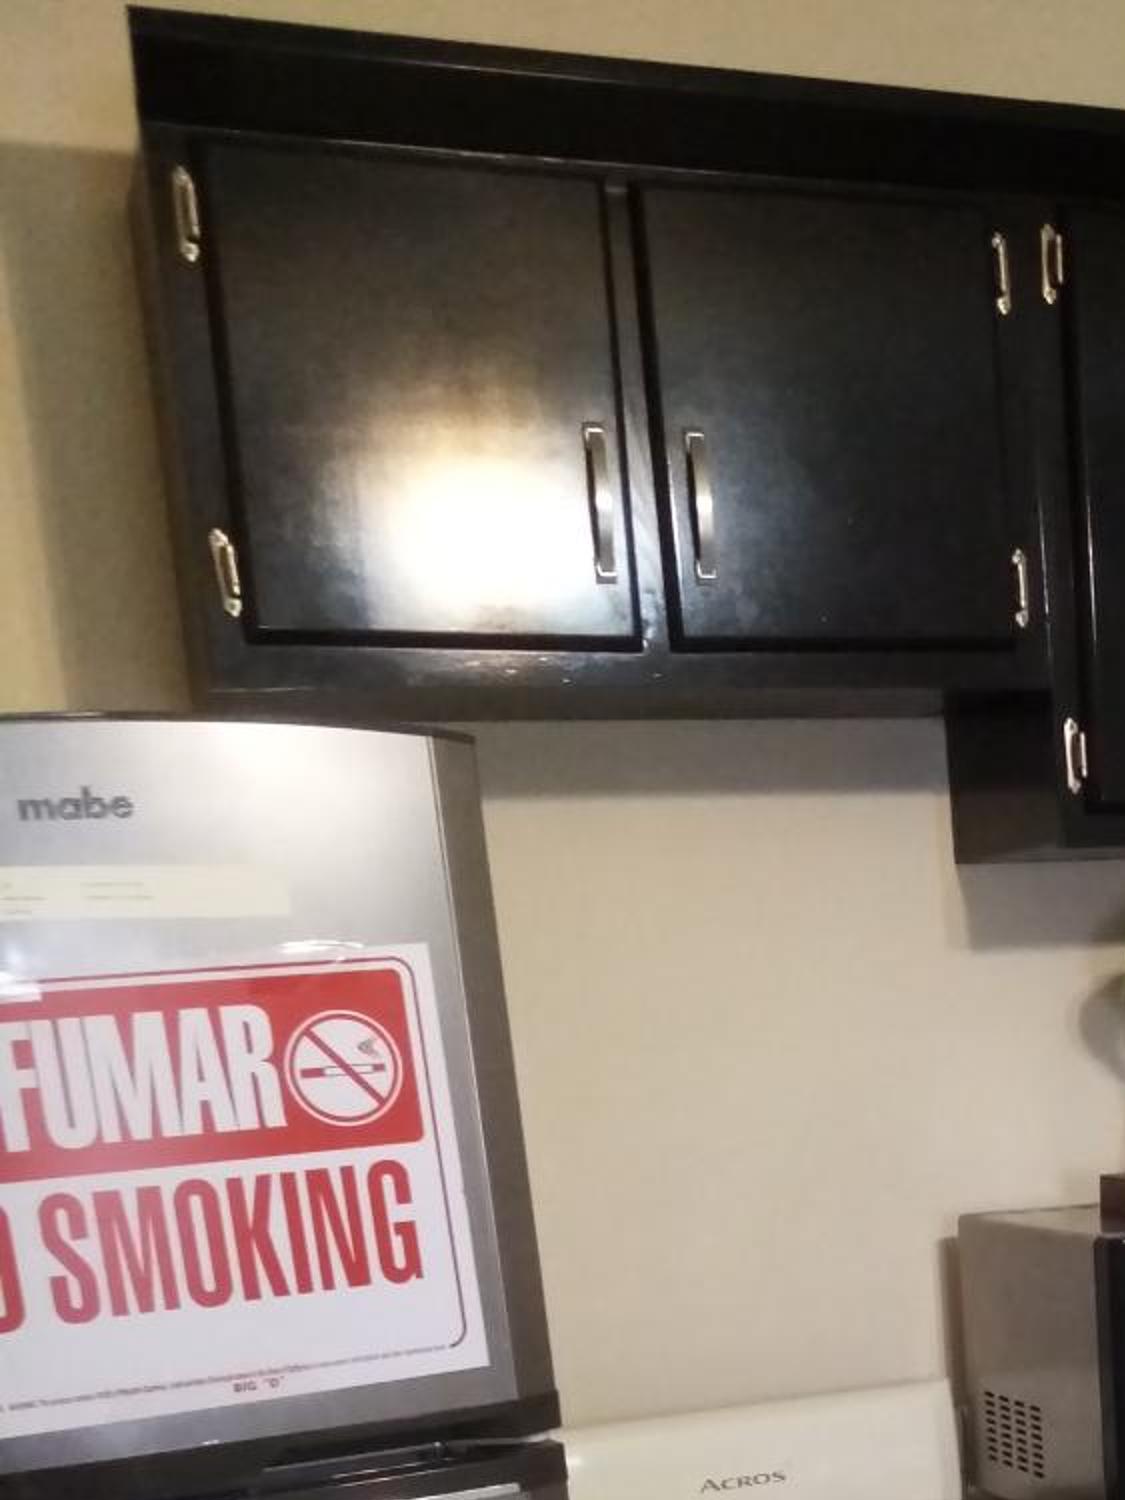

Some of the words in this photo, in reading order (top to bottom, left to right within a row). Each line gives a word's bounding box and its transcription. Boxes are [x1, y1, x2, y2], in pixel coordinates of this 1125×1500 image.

[17, 785, 134, 821] mabe
[0, 1004, 288, 1153] FUMAR
[37, 1159, 424, 1325] SMOKING
[700, 1470, 786, 1494] ACROS
